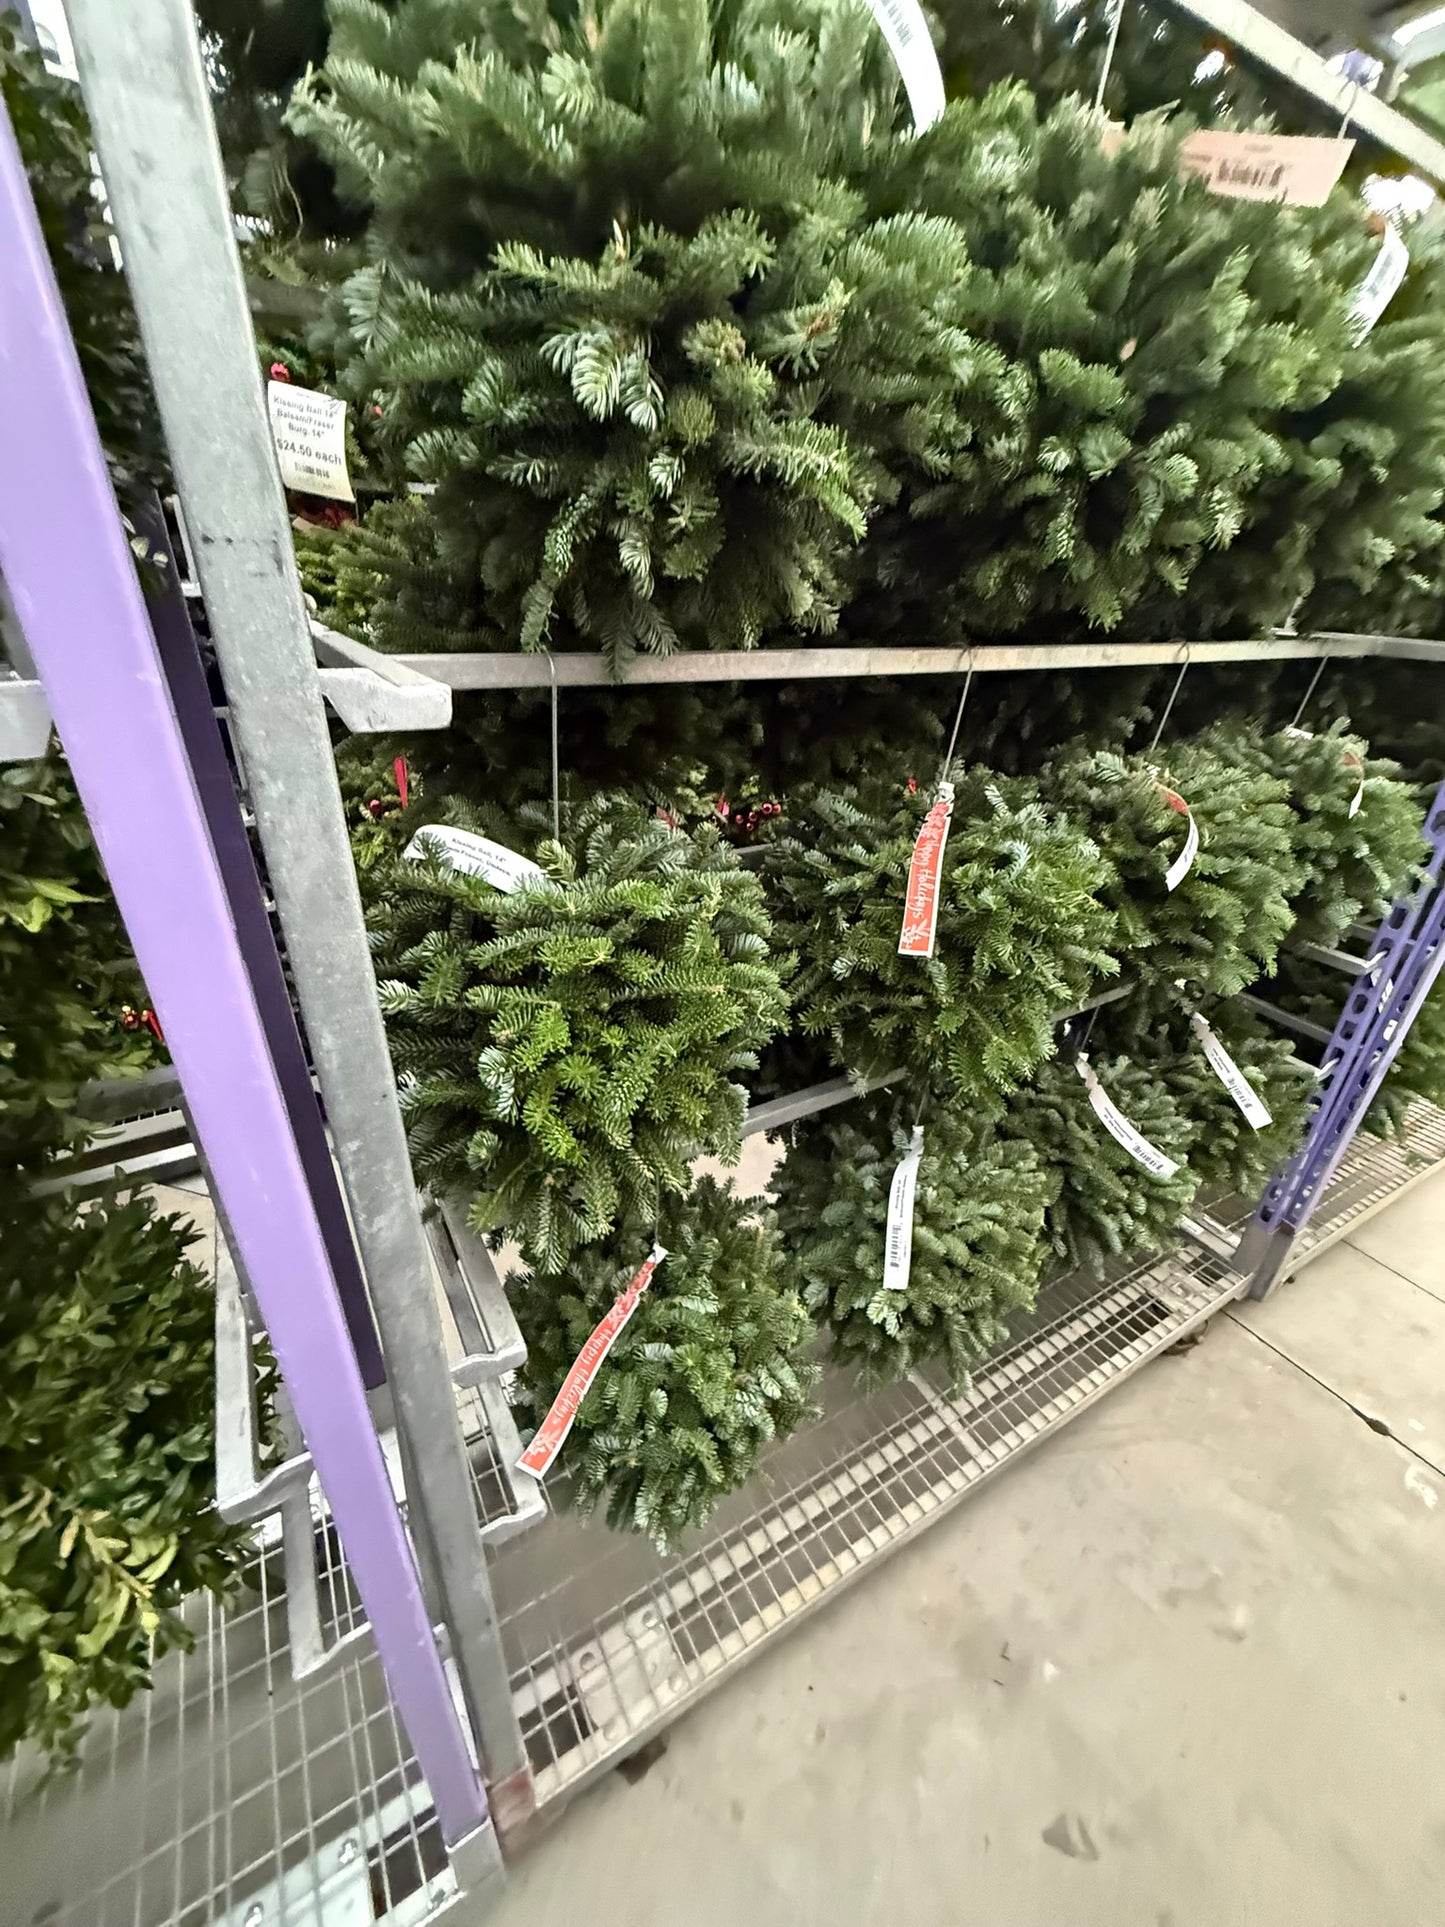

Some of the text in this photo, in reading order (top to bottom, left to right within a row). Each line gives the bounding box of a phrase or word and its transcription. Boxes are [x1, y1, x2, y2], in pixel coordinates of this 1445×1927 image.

[273, 395, 304, 413] Kissing
[306, 404, 322, 416] Ball
[276, 438, 342, 465] $24.50 each
[907, 840, 940, 919] Happy Holidays
[553, 1328, 613, 1425] Happy Holidays
